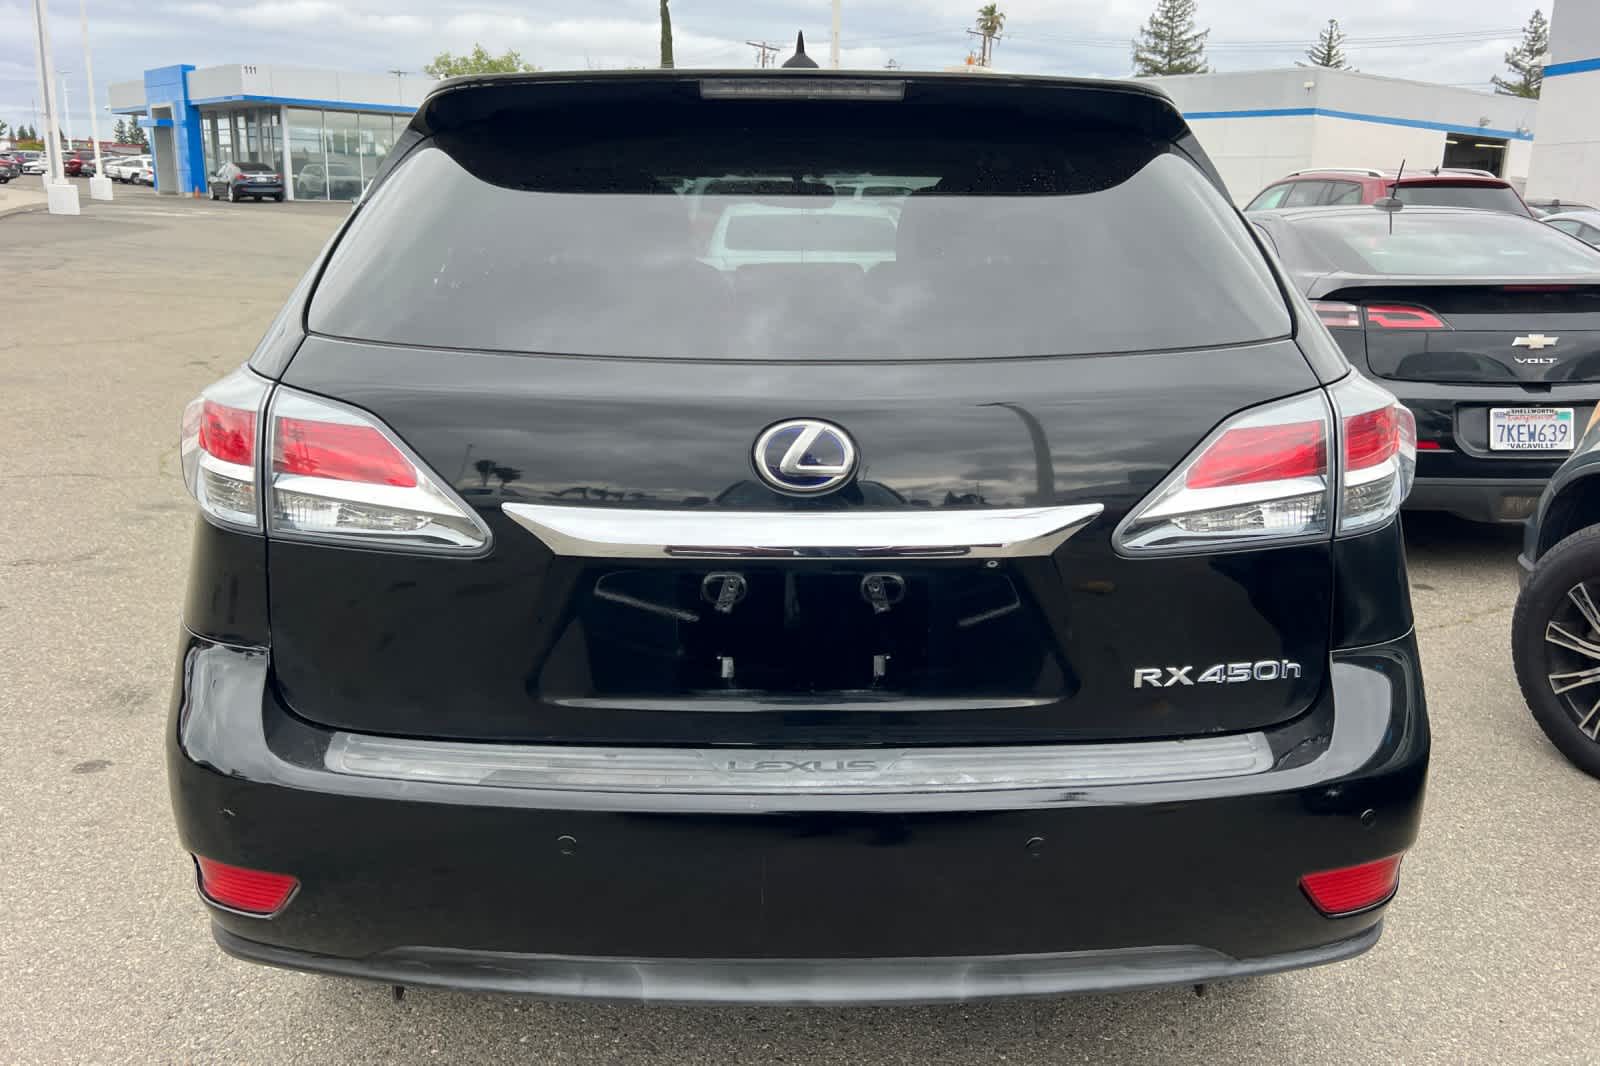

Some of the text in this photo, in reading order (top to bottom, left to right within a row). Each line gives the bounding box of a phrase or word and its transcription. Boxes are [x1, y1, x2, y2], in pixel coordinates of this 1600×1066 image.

[1513, 356, 1558, 364] VOLT
[1496, 423, 1568, 443] 7KEW639
[1133, 659, 1301, 689] RX 450h
[727, 760, 878, 774] LEXUS
